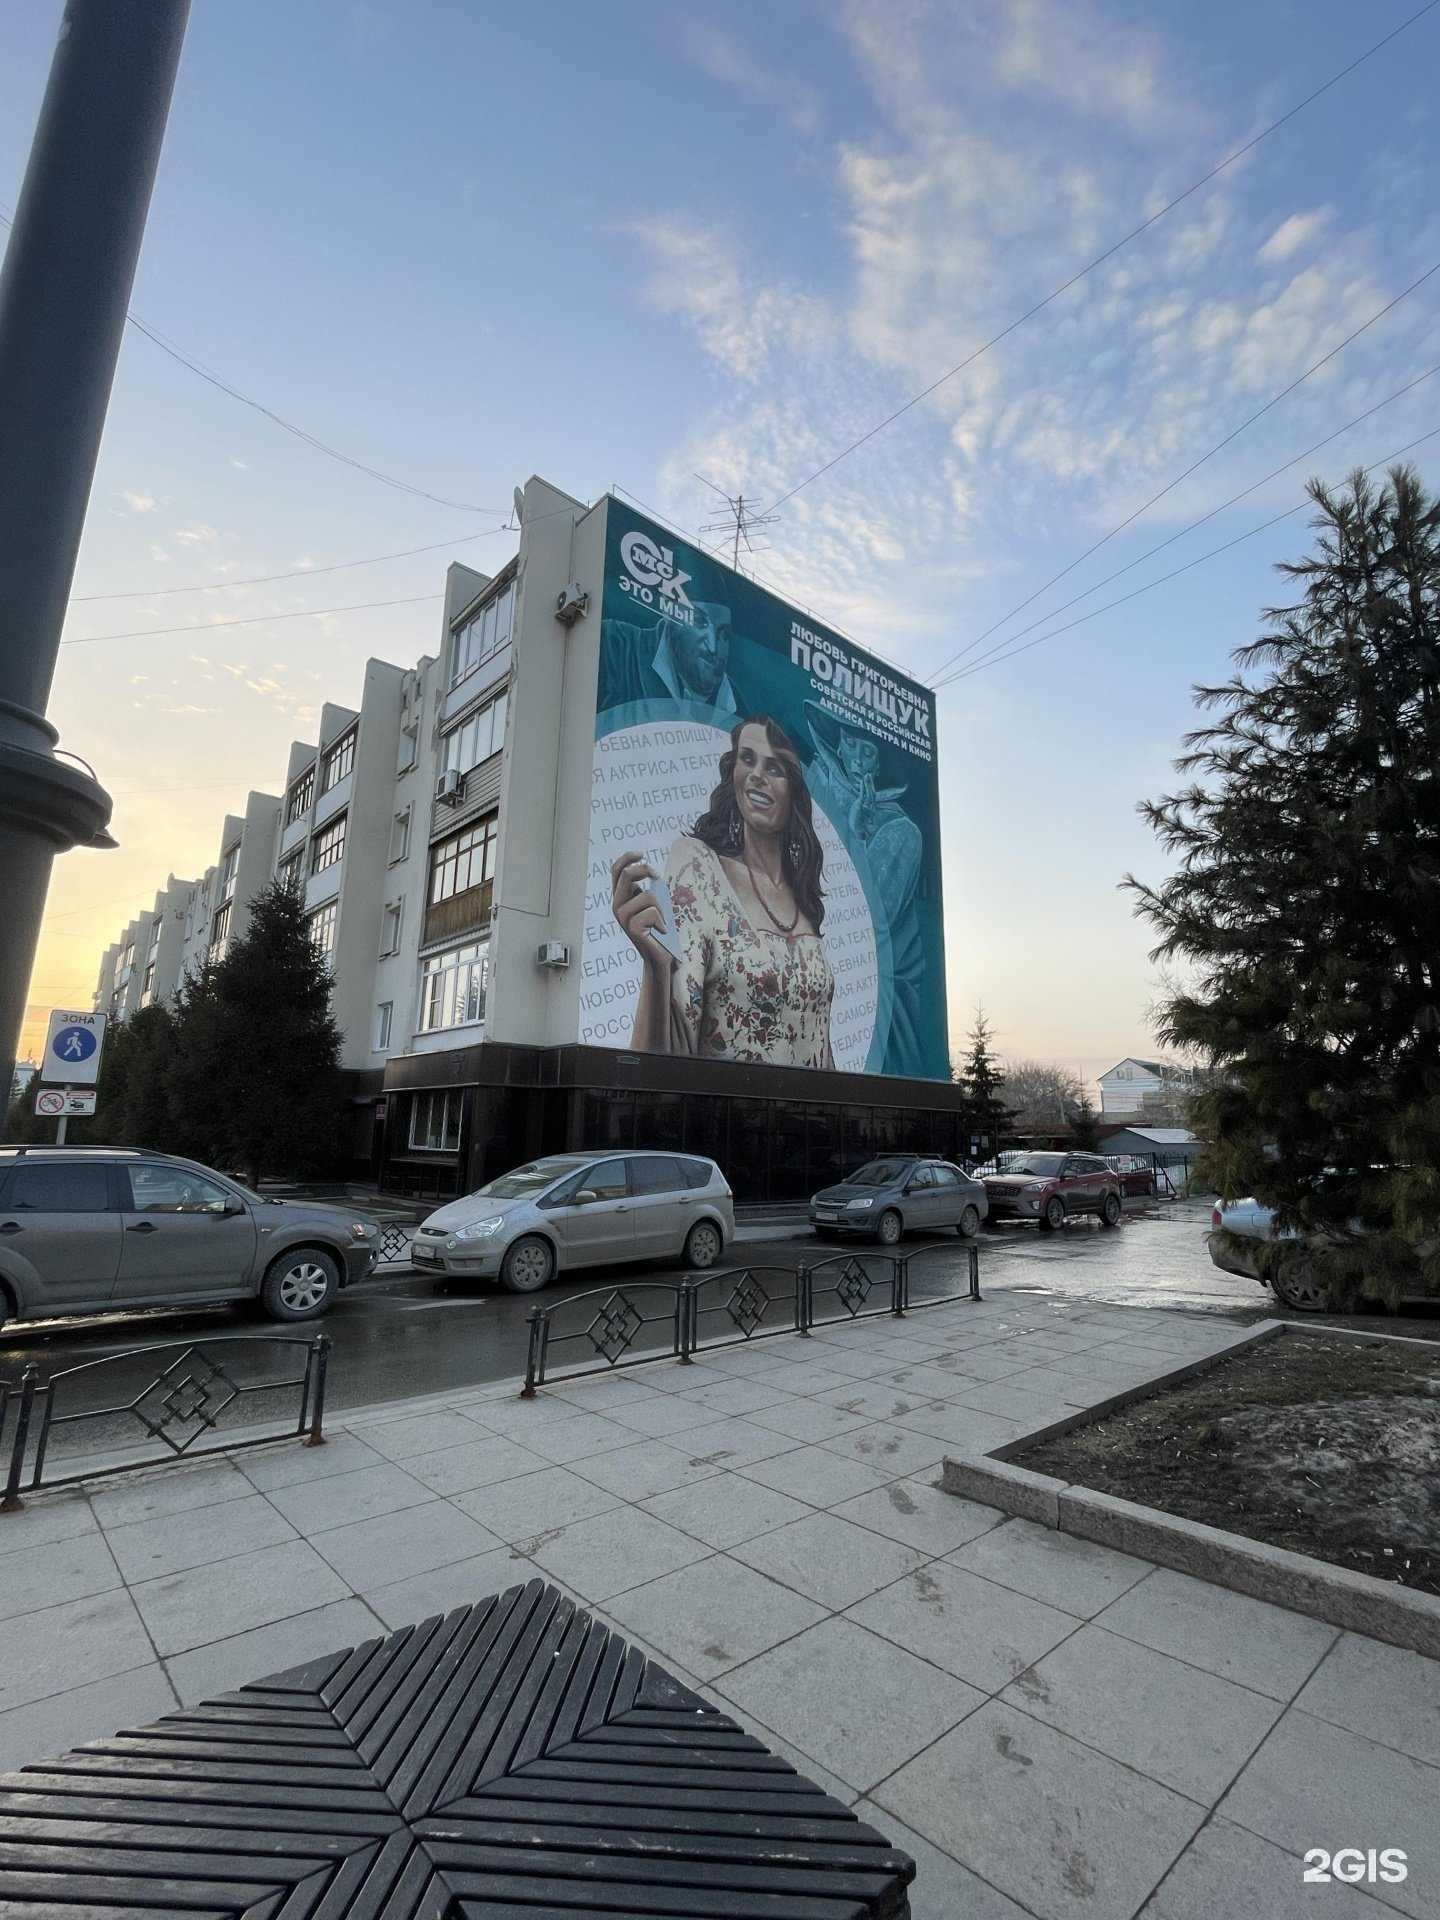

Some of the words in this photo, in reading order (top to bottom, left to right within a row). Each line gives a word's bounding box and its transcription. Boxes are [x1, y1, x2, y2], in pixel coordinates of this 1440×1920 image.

[618, 575, 653, 603] ЭТО
[791, 622, 849, 663] ЛЮБОВЬ
[851, 657, 929, 712] ГРИГОРЬЕВНА
[791, 637, 930, 737] ПОЛИЩУК
[810, 678, 866, 716] СОВЕТСКАЯ
[868, 707, 875, 720] И
[877, 715, 931, 750] РОССИЙСКАЯ
[820, 697, 864, 730] АКТРИСА
[866, 721, 900, 747] ТЕАТРА
[901, 740, 909, 752] И
[909, 744, 932, 762] КИНО
[610, 758, 678, 780] АКТРИСА
[642, 782, 708, 808] ДЕЯТЕЛЬ
[61, 1014, 95, 1025] ЗОНА
